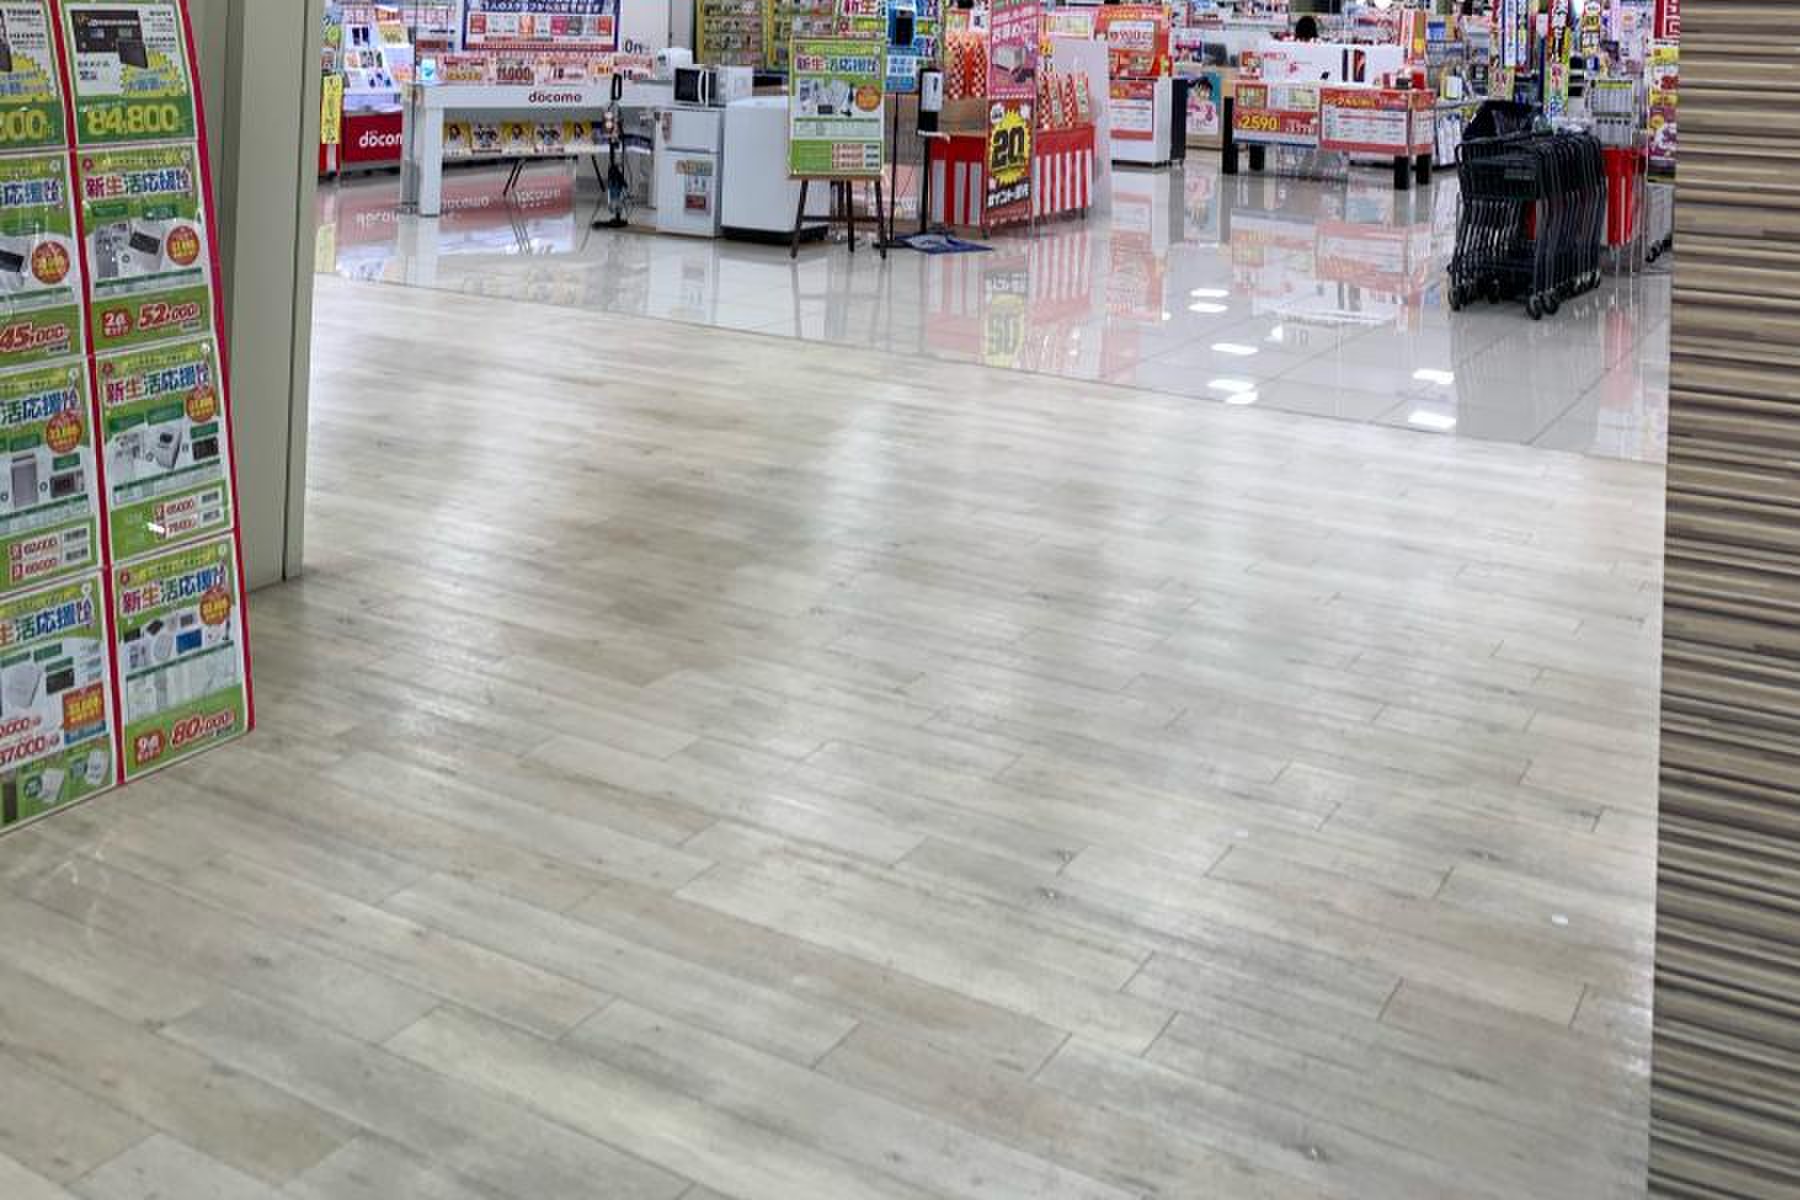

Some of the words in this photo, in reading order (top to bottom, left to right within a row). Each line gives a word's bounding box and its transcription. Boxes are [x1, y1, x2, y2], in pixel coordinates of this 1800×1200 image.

[528, 87, 583, 104] docomo
[87, 104, 179, 135] 84,800
[1241, 115, 1278, 131] 2590
[991, 126, 1025, 169] 20
